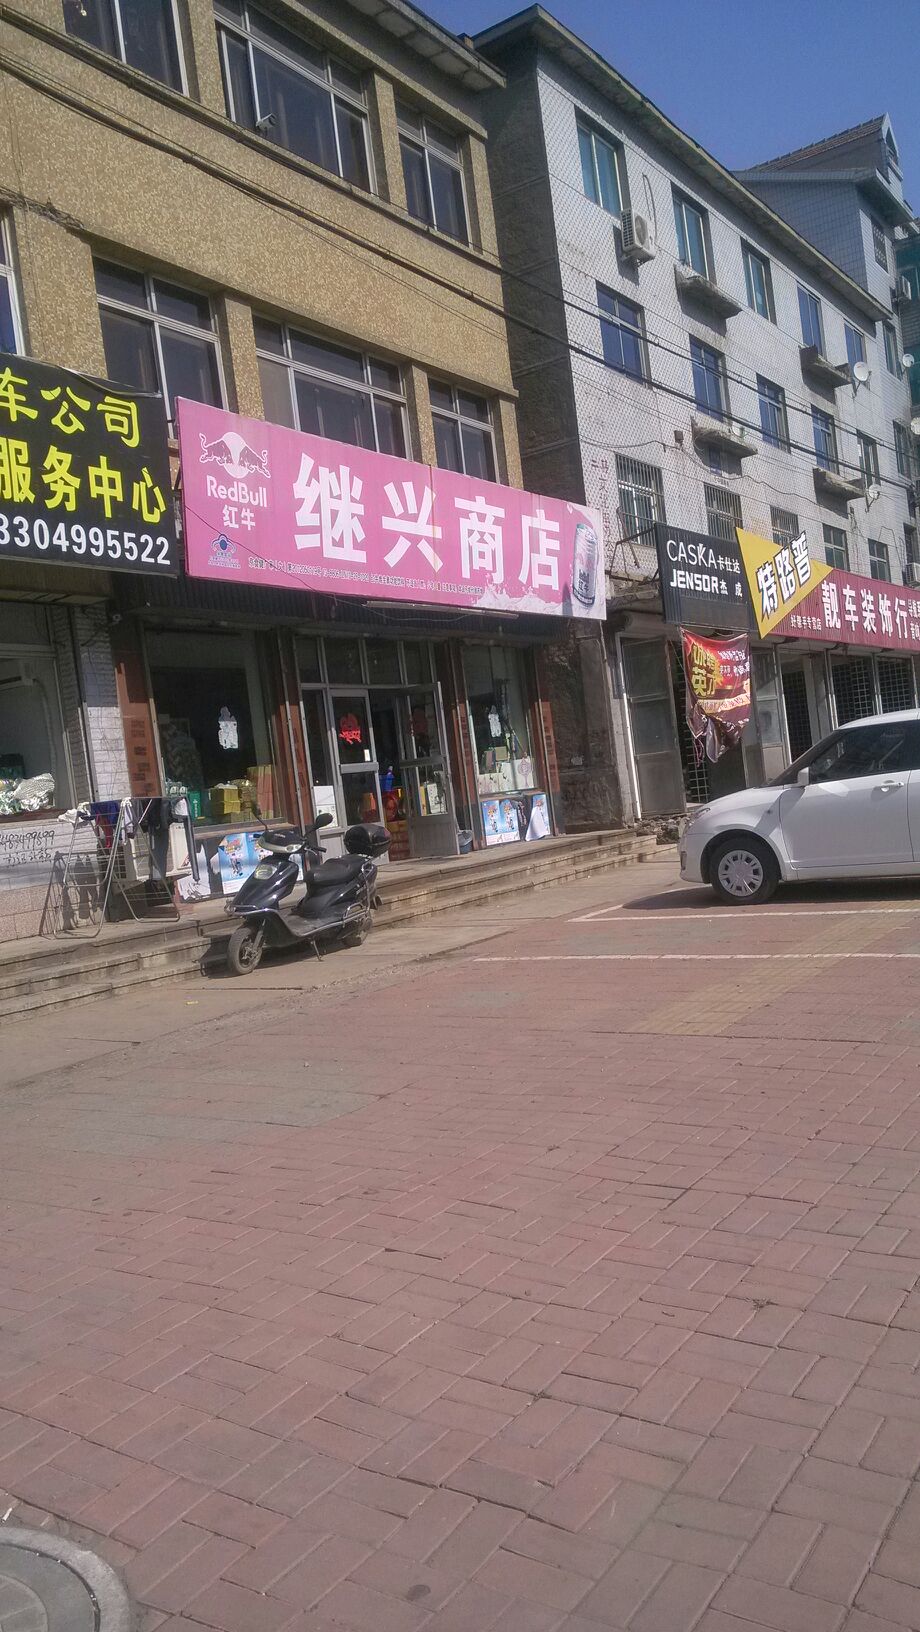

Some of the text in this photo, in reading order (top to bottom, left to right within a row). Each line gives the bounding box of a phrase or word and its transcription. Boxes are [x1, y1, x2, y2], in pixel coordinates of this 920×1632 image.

[0, 367, 140, 448] 车公司
[0, 437, 167, 523] 服务中心
[222, 504, 256, 531] 红牛
[293, 452, 561, 592] 继兴商店
[666, 540, 741, 574] CASKA 卡仕达
[670, 568, 719, 594] JENSOR
[821, 580, 908, 639] 靓车装饰行
